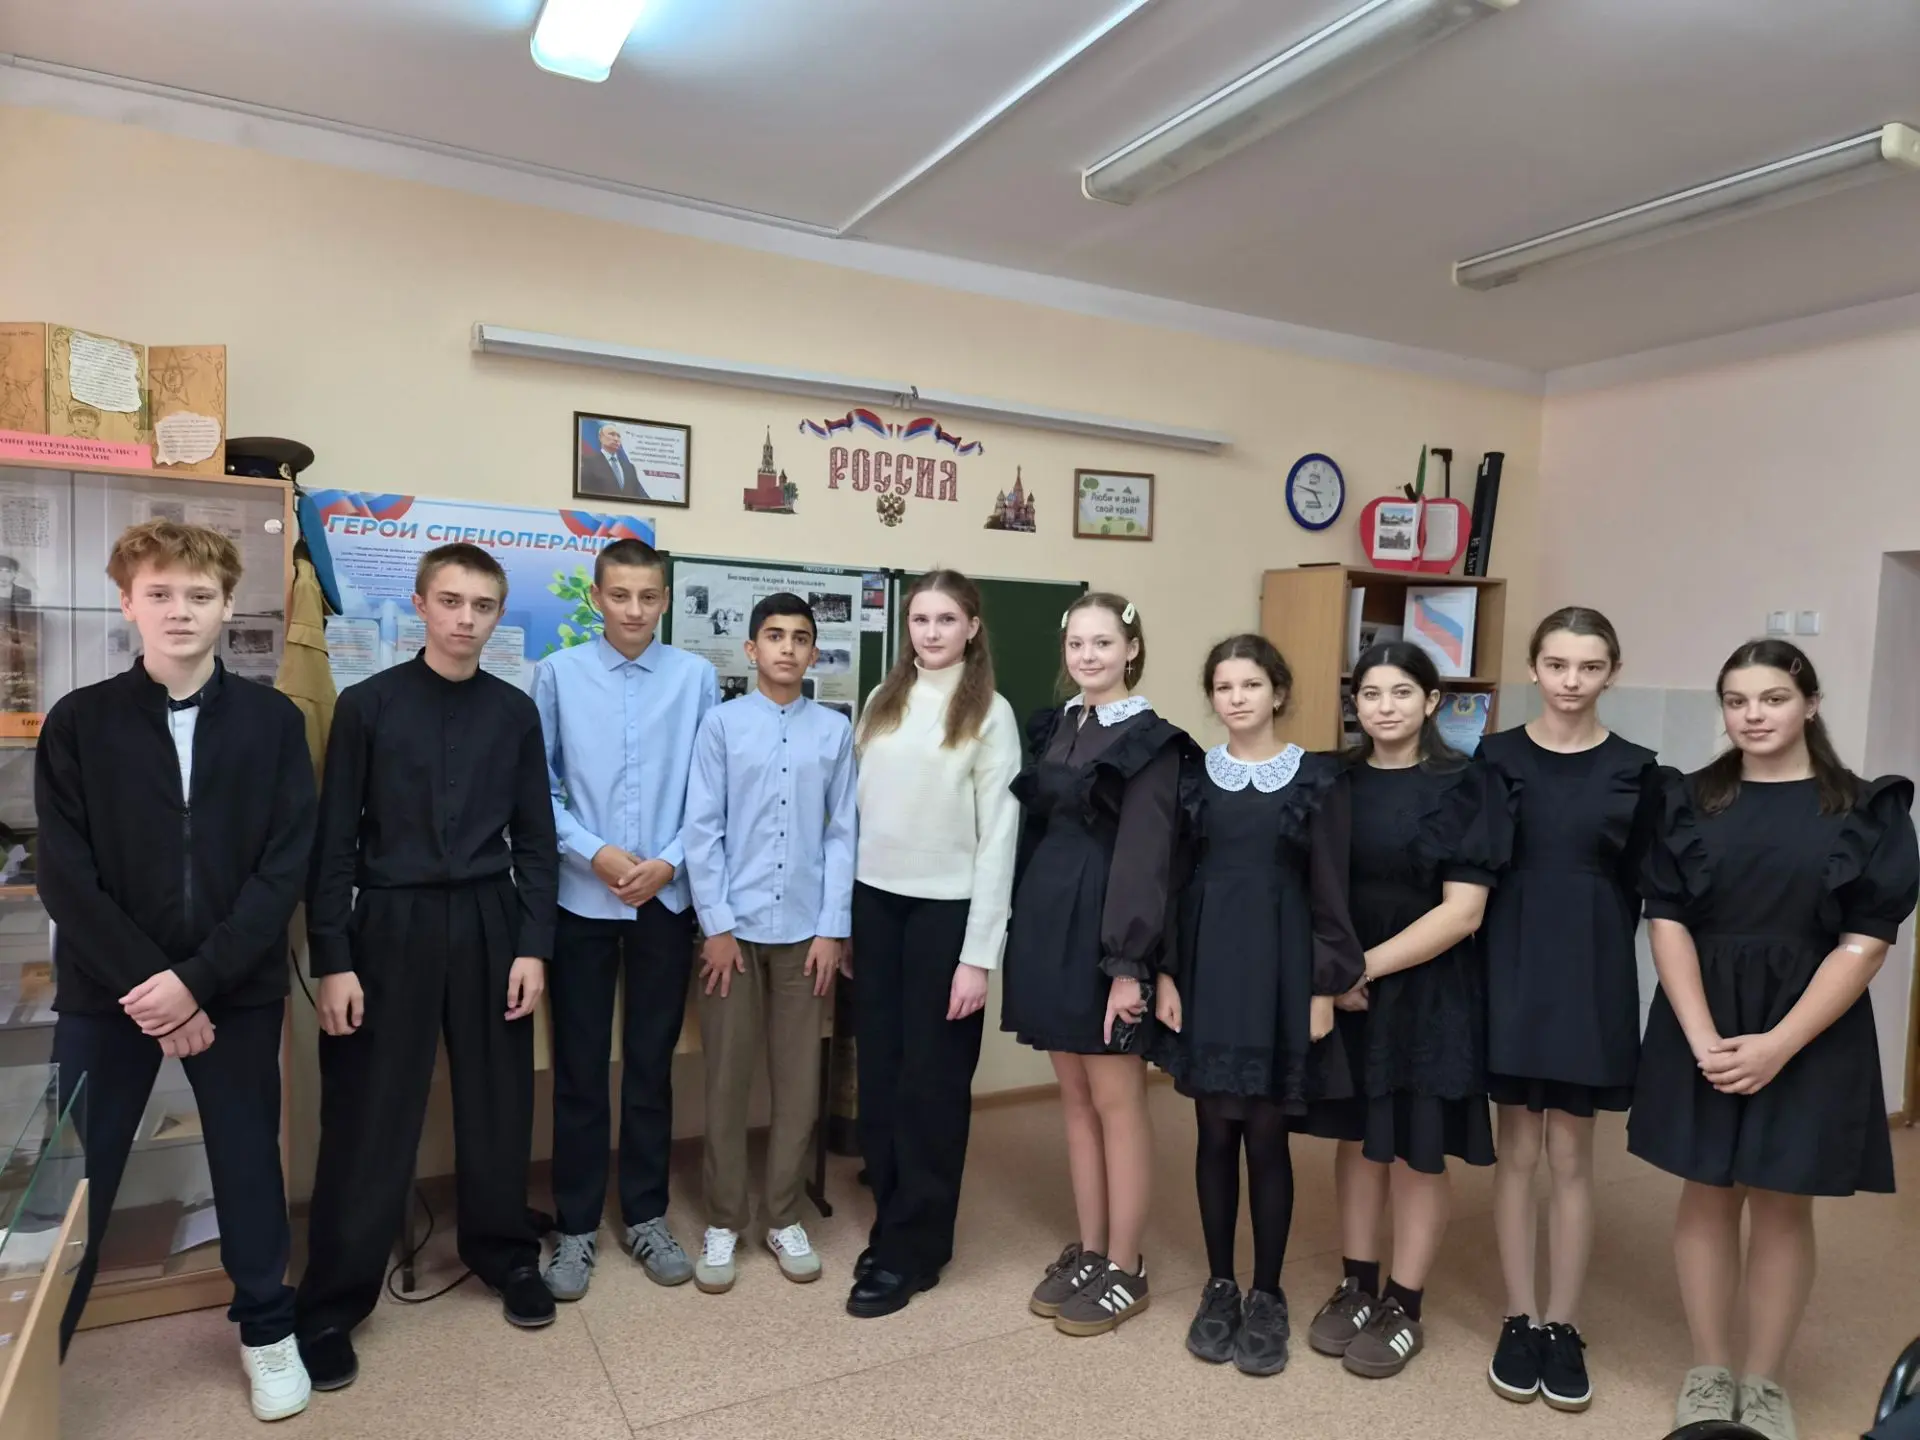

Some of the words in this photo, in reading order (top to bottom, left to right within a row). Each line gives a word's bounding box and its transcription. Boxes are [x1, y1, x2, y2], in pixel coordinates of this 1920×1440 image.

[828, 446, 958, 502] РОССИЯ
[1090, 492, 1113, 502] Люби
[1122, 495, 1140, 504] знай
[1095, 504, 1114, 513] свой
[1115, 506, 1137, 515] край!
[327, 515, 418, 540] ГЕРОИ
[762, 575, 784, 584] Андрей
